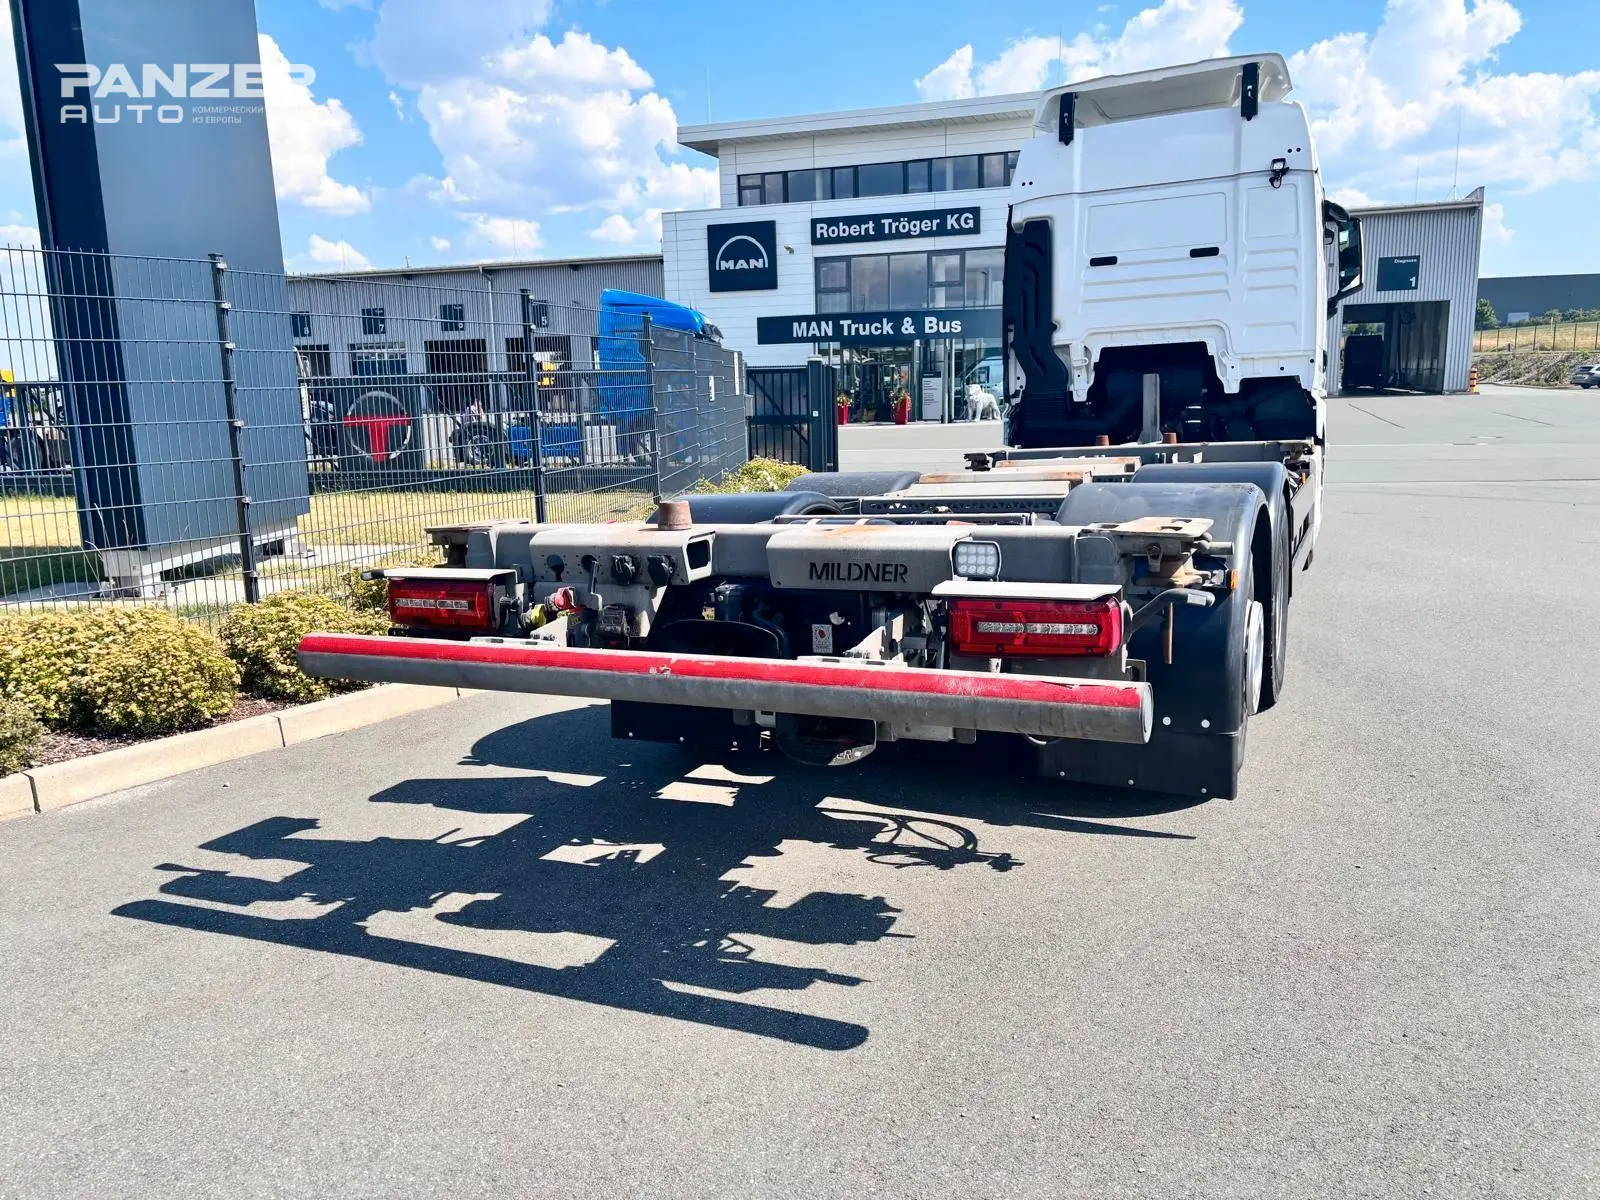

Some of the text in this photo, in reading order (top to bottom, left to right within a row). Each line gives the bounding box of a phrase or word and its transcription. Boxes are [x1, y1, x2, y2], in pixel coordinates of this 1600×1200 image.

[816, 212, 975, 239] Robert Tröger KG
[720, 258, 764, 271] MAN
[1409, 276, 1416, 287] 1
[792, 316, 962, 338] MAN Truck & Bus
[809, 562, 908, 583] MILDNER
